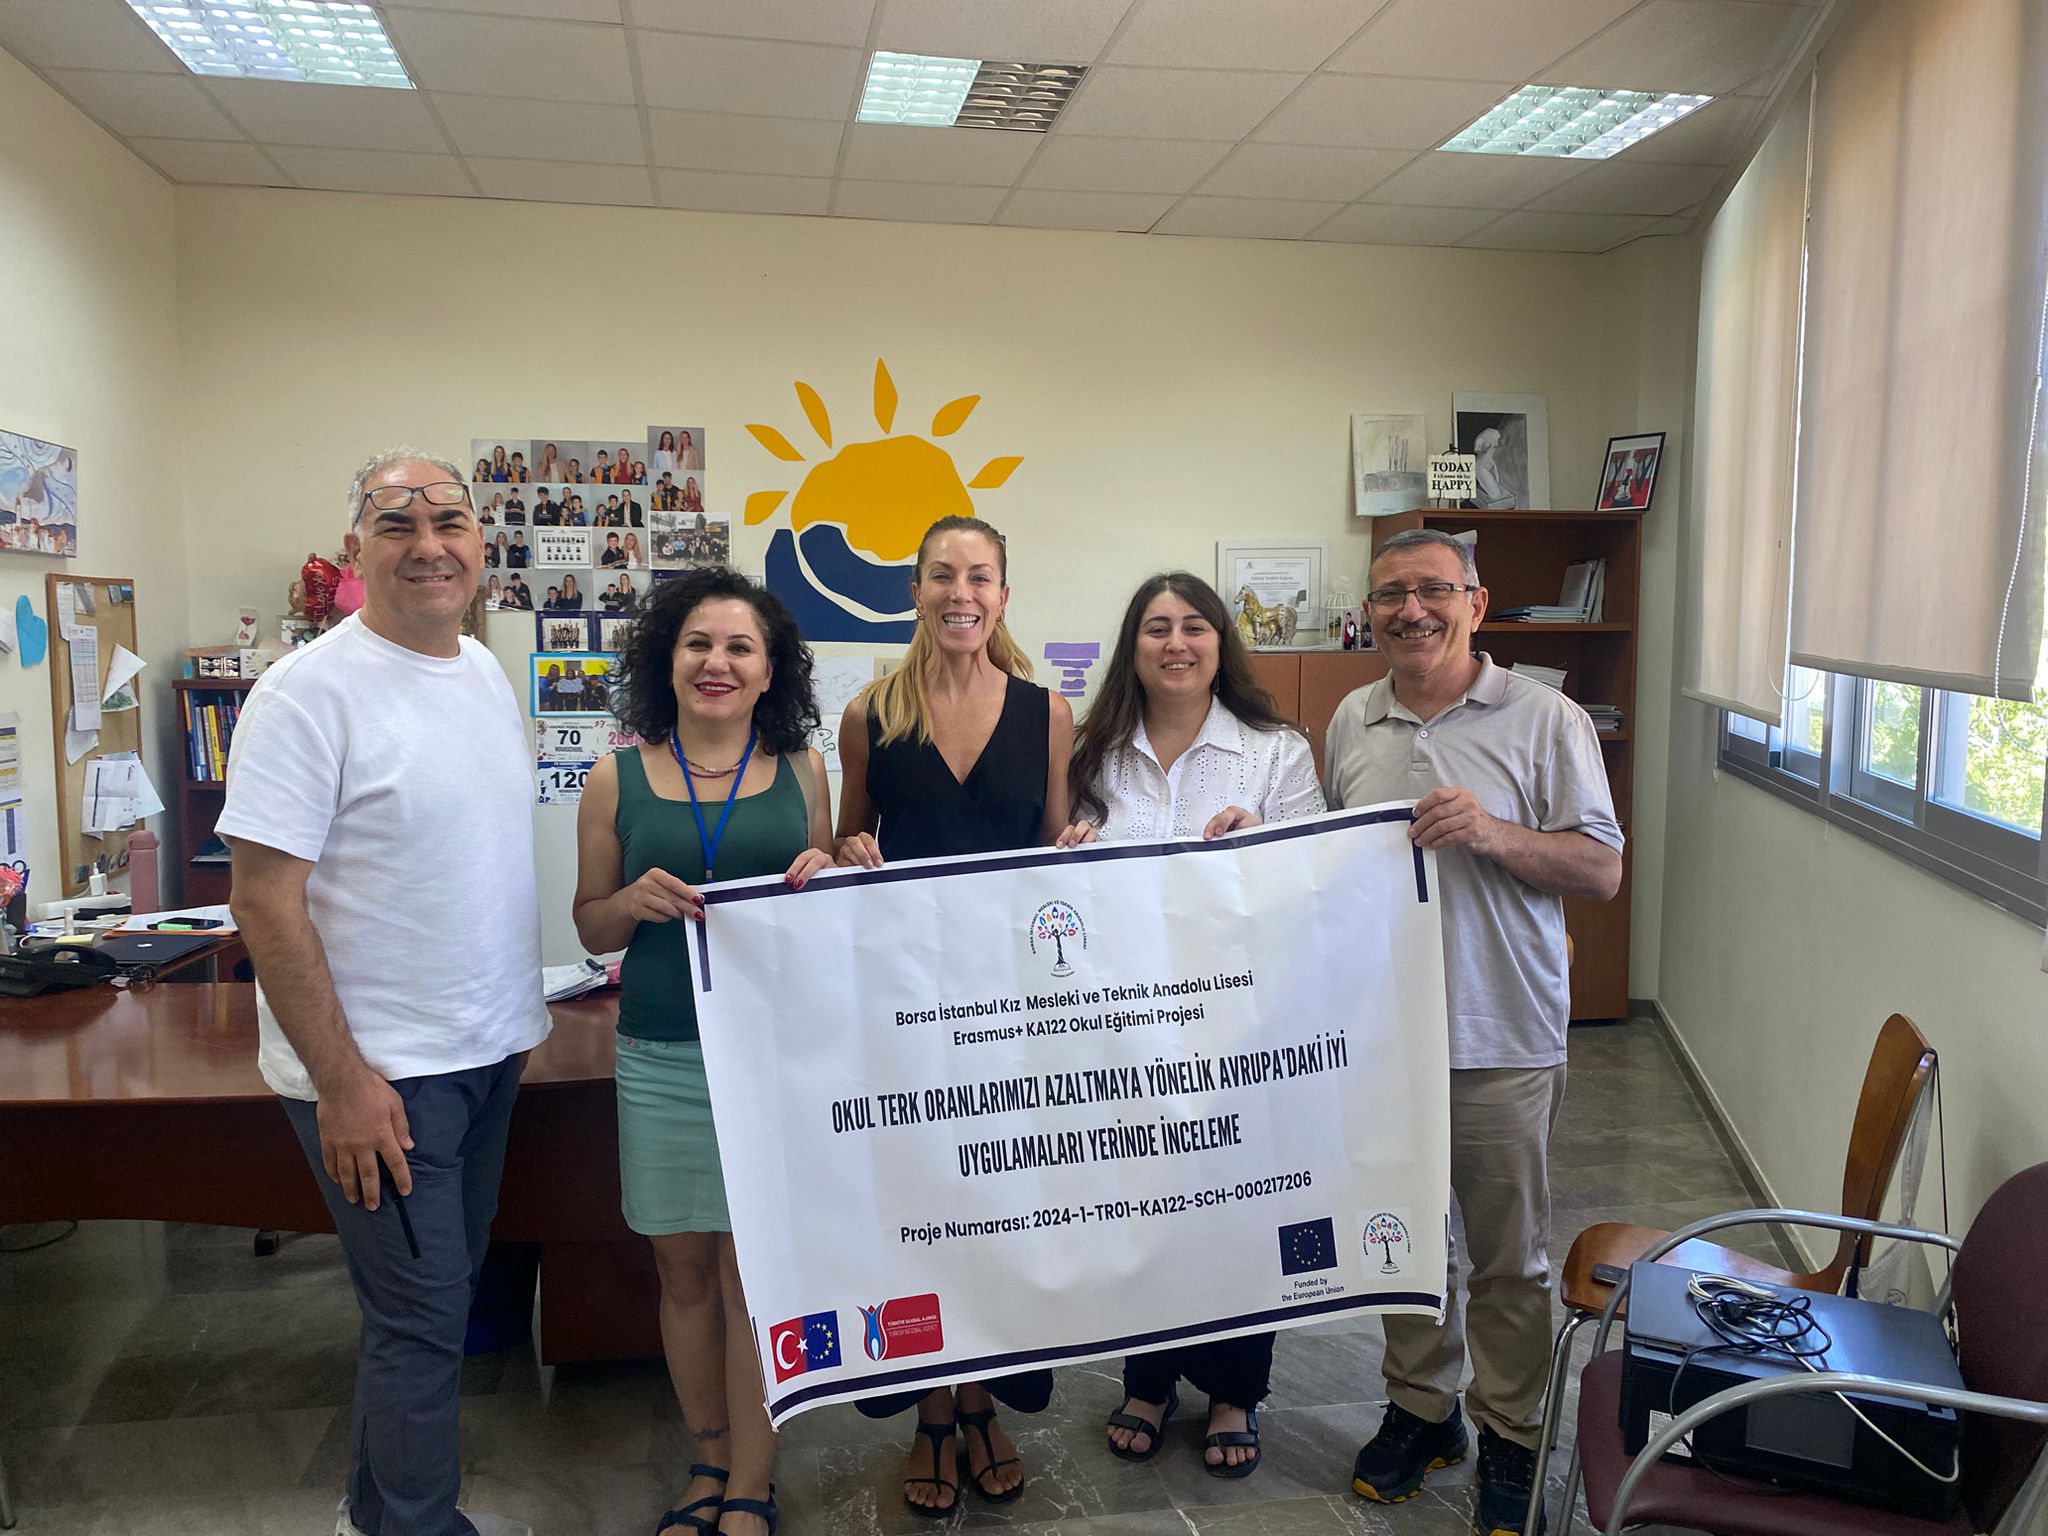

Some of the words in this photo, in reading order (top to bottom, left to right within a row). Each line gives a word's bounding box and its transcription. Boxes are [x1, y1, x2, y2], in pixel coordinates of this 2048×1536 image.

[1431, 462, 1472, 472] TODAY
[1432, 480, 1472, 490] HAPPY
[557, 730, 581, 745] 70
[896, 1011, 936, 1026] Borsa
[939, 999, 997, 1020] İstanbul
[1000, 998, 1021, 1013] Kız
[1026, 989, 1079, 1010] Mesleki
[1083, 991, 1100, 1004] ve
[1102, 983, 1150, 1002] Teknik
[1153, 977, 1211, 998] Anadolu
[1214, 970, 1253, 990] Lisesi
[954, 1025, 1023, 1046] Erasmus+
[1026, 1019, 1067, 1037] KA122
[1069, 1015, 1102, 1032] Okul
[1105, 1009, 1154, 1033] Eğitimi
[1157, 1003, 1204, 1026] Projesi
[832, 1097, 875, 1133] OKUL
[877, 1091, 921, 1127] TERK
[924, 1076, 1040, 1122] ORANLARIMIZI
[1046, 1066, 1143, 1106] AZALTMAYA
[1145, 1053, 1215, 1097] YÖNELİK
[1219, 1034, 1324, 1089] AVRUPA'DAKİ
[1326, 1029, 1348, 1070] İYİ
[958, 1131, 1085, 1177] UYGULAMALARI
[1087, 1119, 1159, 1162] YERİNDE
[1160, 1113, 1242, 1154] İNCELEME
[901, 1222, 942, 1245] Proje
[945, 1215, 1030, 1238] Numarası:
[1033, 1170, 1312, 1227] 2024-1-TR01-KA122-SCH-000217206
[1282, 1294, 1292, 1302] the
[1294, 1290, 1324, 1299] European
[1325, 1286, 1344, 1294] Union
[1294, 1278, 1318, 1288] Funded
